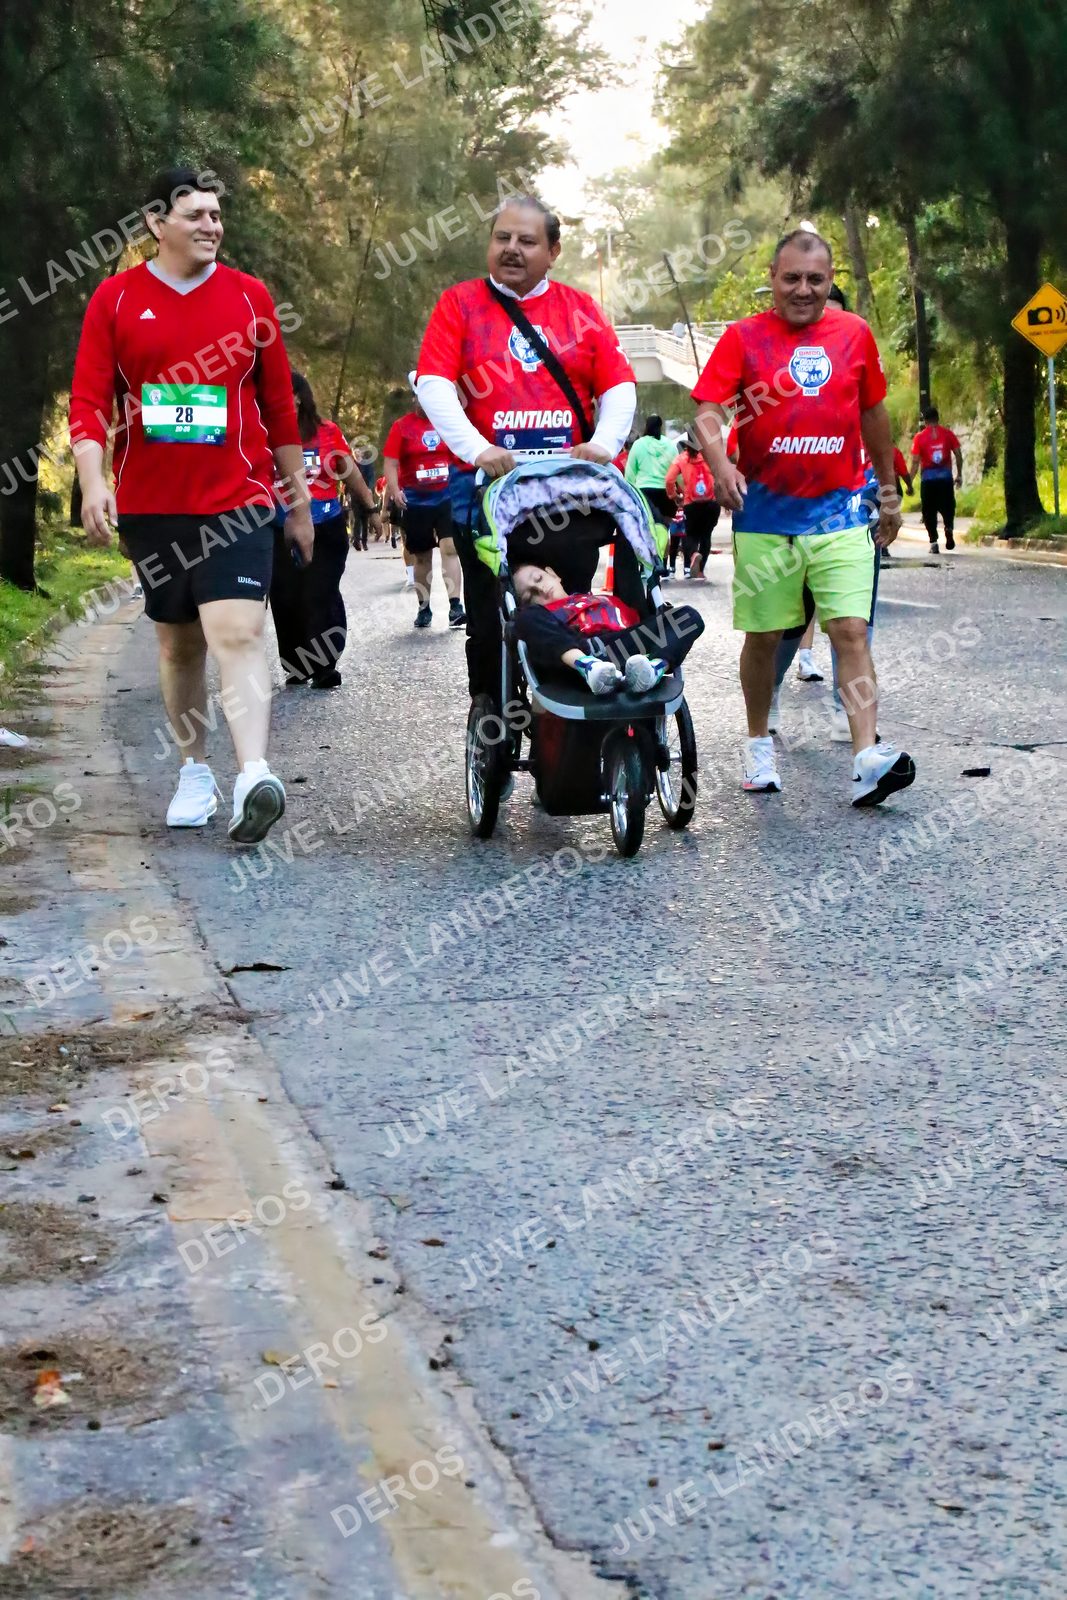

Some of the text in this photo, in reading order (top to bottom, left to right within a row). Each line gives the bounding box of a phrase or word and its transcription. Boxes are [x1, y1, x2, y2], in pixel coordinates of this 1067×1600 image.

[175, 406, 193, 423] 28
[492, 410, 572, 430] SANTIAGO
[770, 436, 845, 454] SANTIAGO
[237, 576, 262, 587] Wilson
